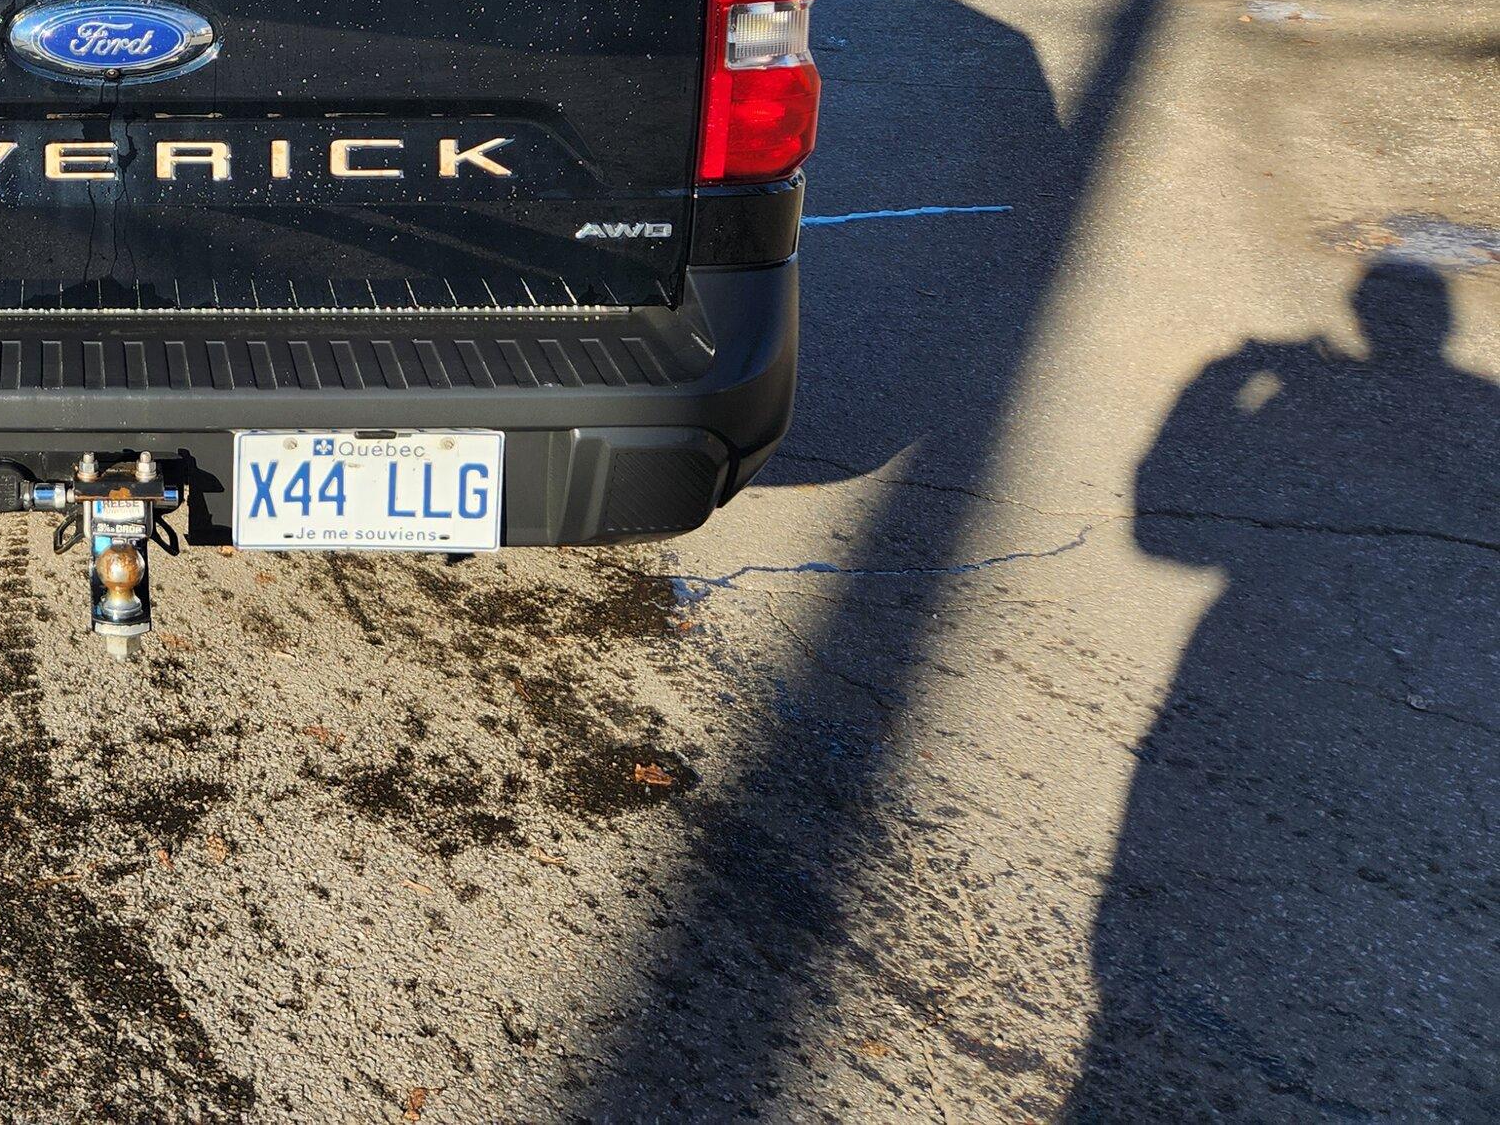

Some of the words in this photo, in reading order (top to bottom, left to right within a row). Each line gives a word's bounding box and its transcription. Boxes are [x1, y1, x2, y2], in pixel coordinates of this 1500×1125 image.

[68, 21, 156, 57] Ford
[574, 222, 673, 239] AWD
[248, 459, 347, 519] X44
[387, 460, 490, 520] LLG
[295, 527, 316, 541] Je
[322, 529, 349, 540] me
[355, 527, 437, 541] souviens
